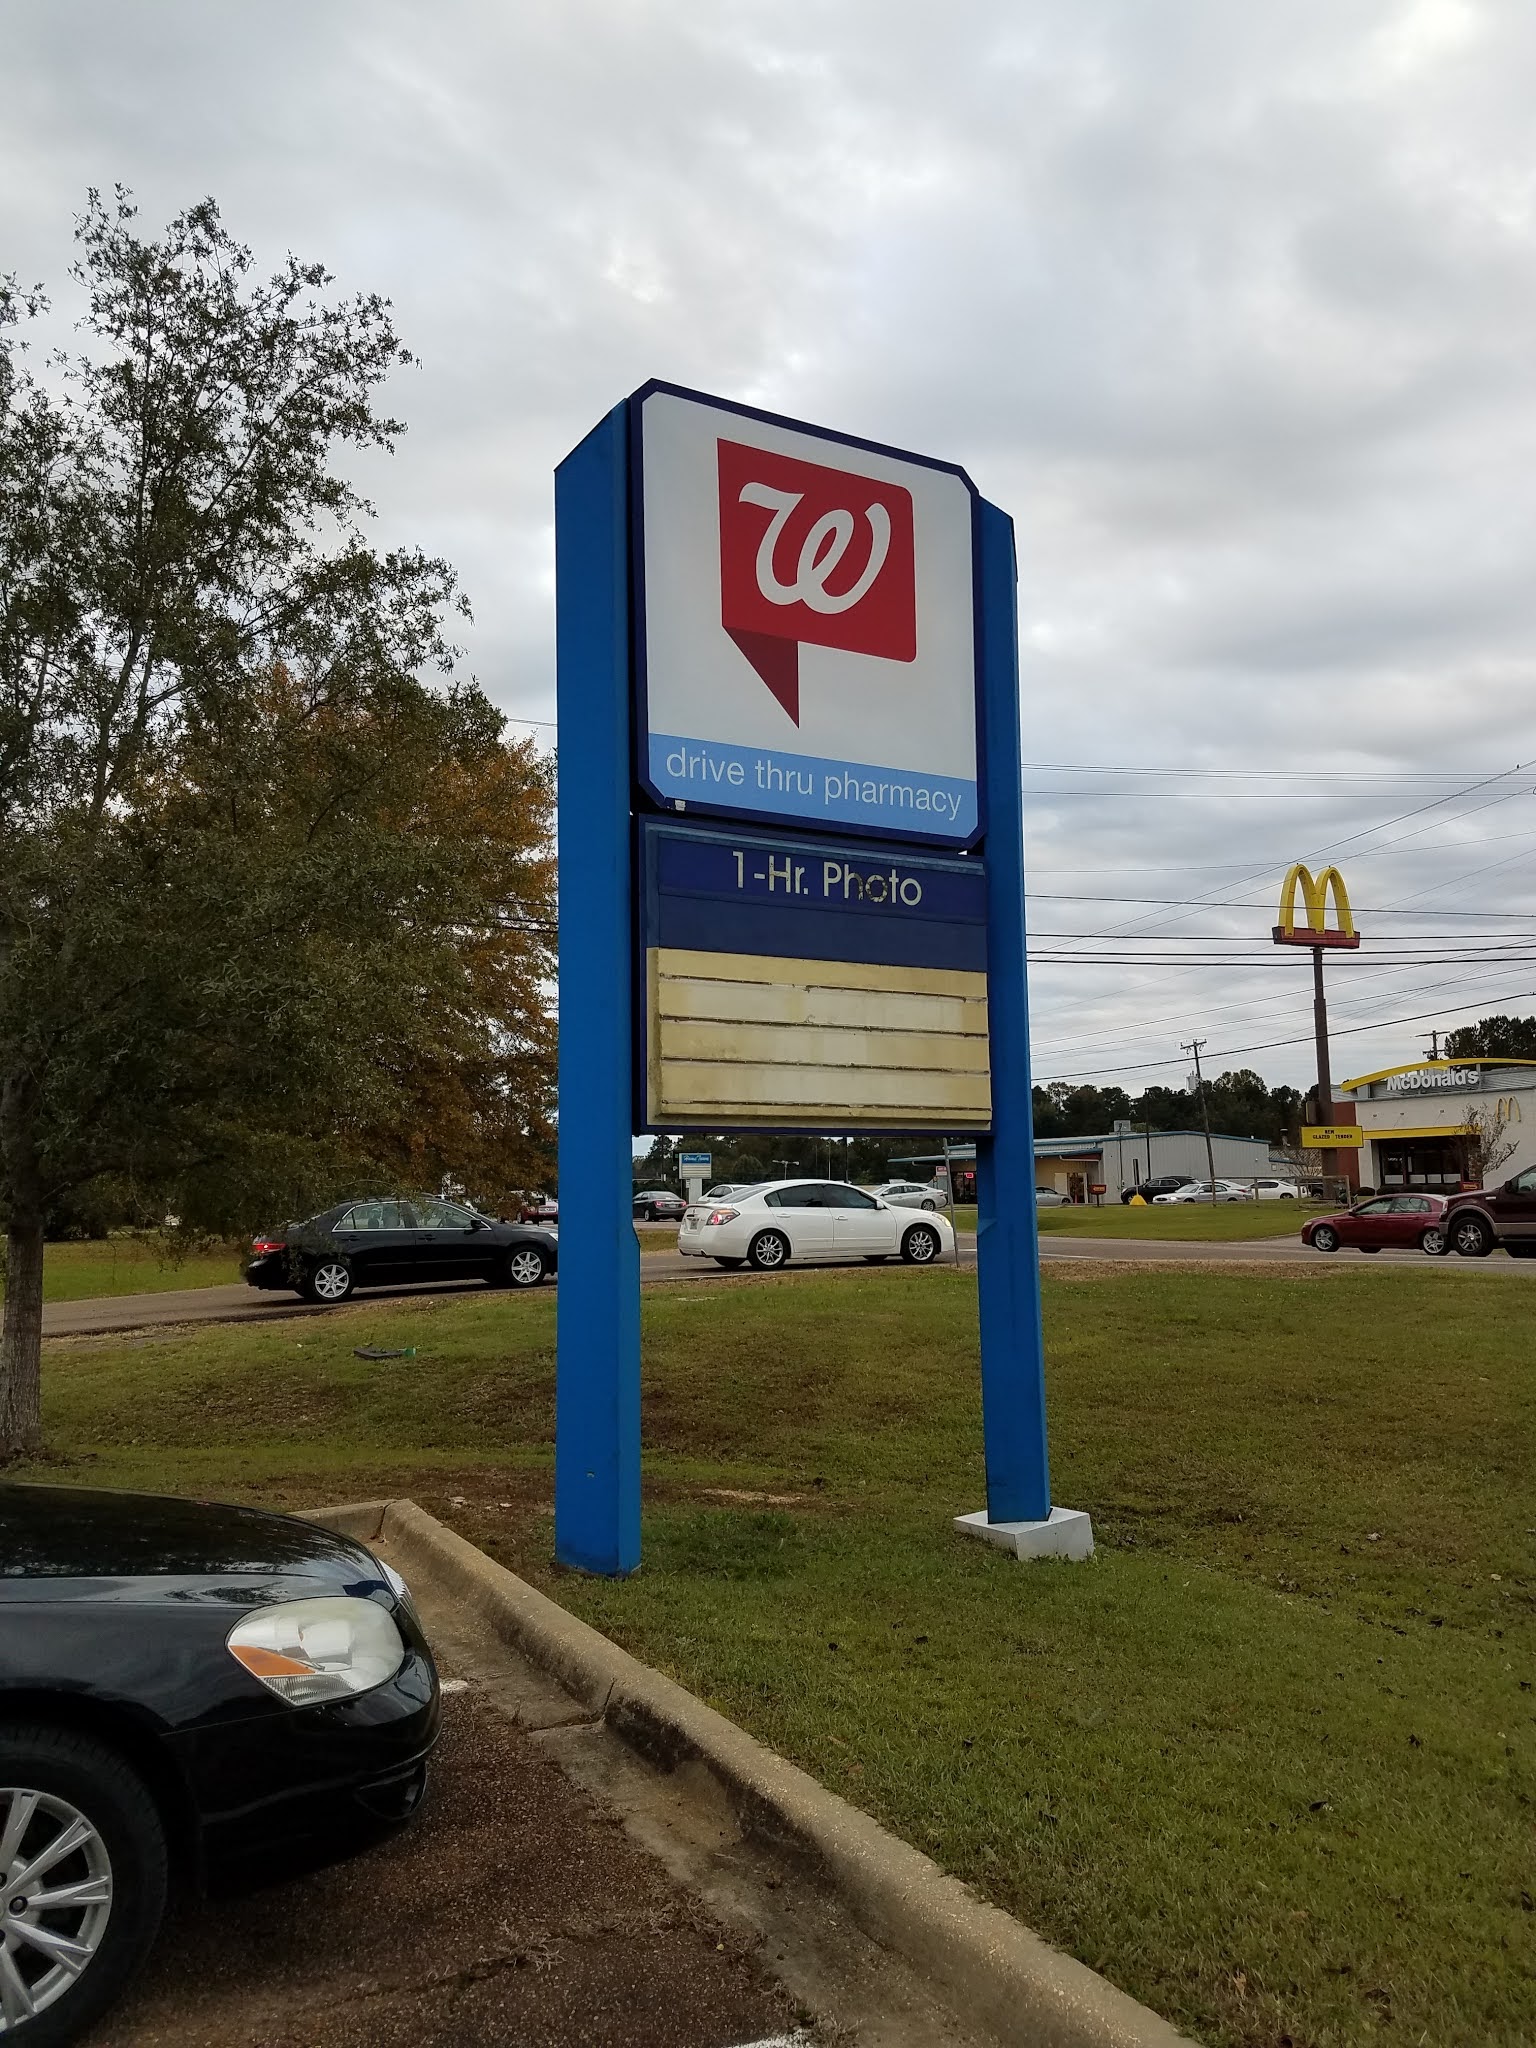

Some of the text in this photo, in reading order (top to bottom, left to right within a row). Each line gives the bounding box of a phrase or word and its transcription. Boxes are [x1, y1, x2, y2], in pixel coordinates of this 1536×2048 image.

[666, 747, 962, 821] drive thru pharmacy
[732, 851, 922, 906] 1-Hr. Photo
[1386, 1066, 1480, 1091] McDonald's
